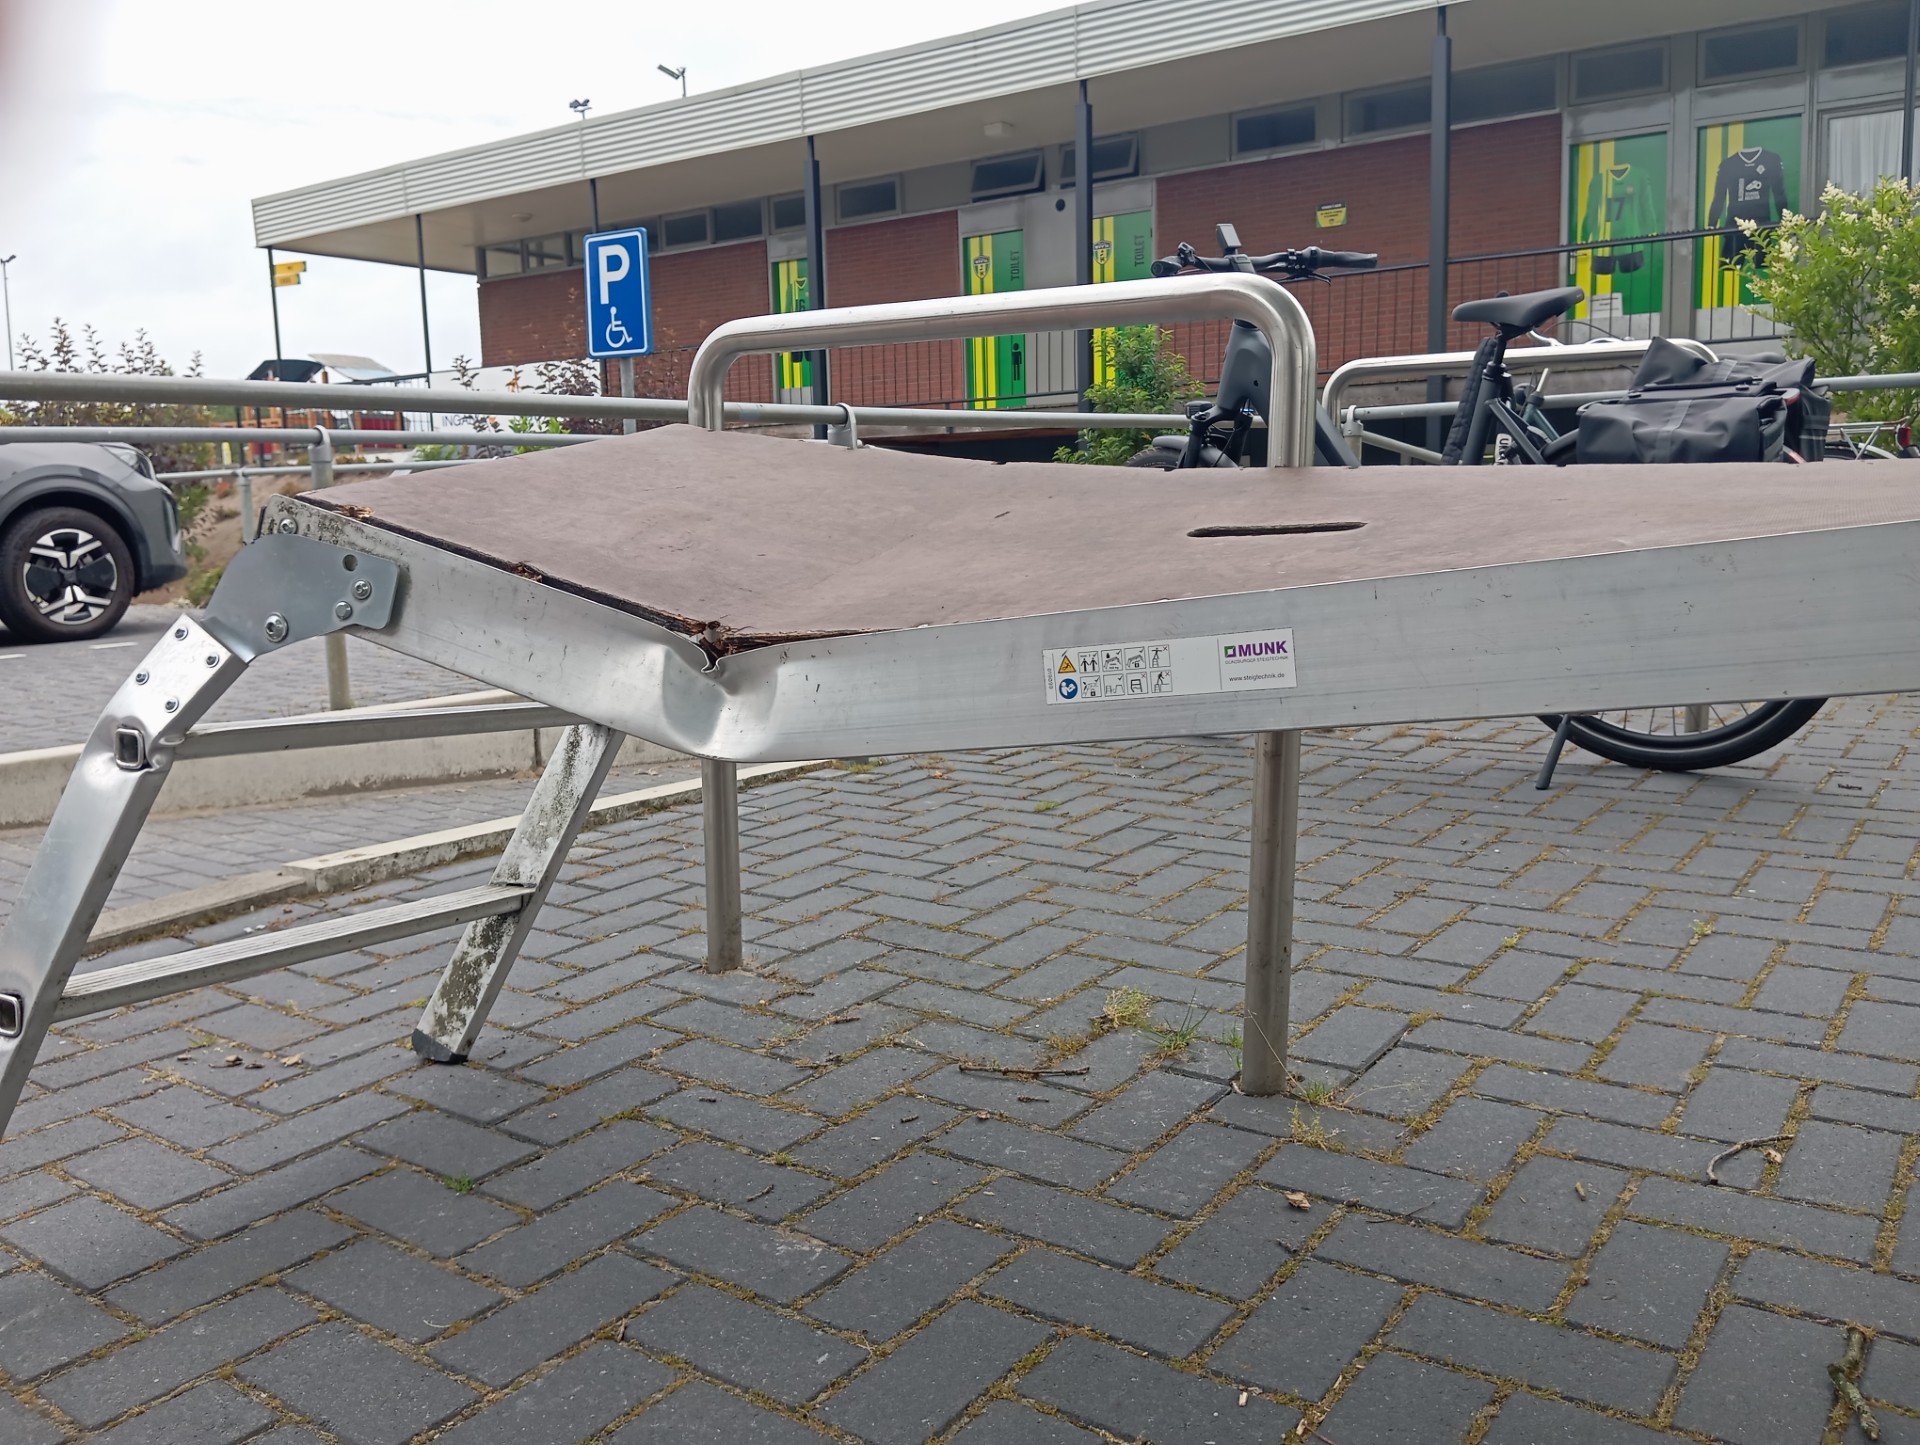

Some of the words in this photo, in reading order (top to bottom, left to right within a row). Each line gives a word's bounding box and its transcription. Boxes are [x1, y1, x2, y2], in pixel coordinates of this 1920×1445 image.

[1010, 250, 1020, 281] TOILET
[1134, 235, 1145, 267] TOILET
[598, 244, 631, 305] P
[1238, 640, 1288, 657] MUNK
[1229, 672, 1285, 682] www.steigtechnik.de
